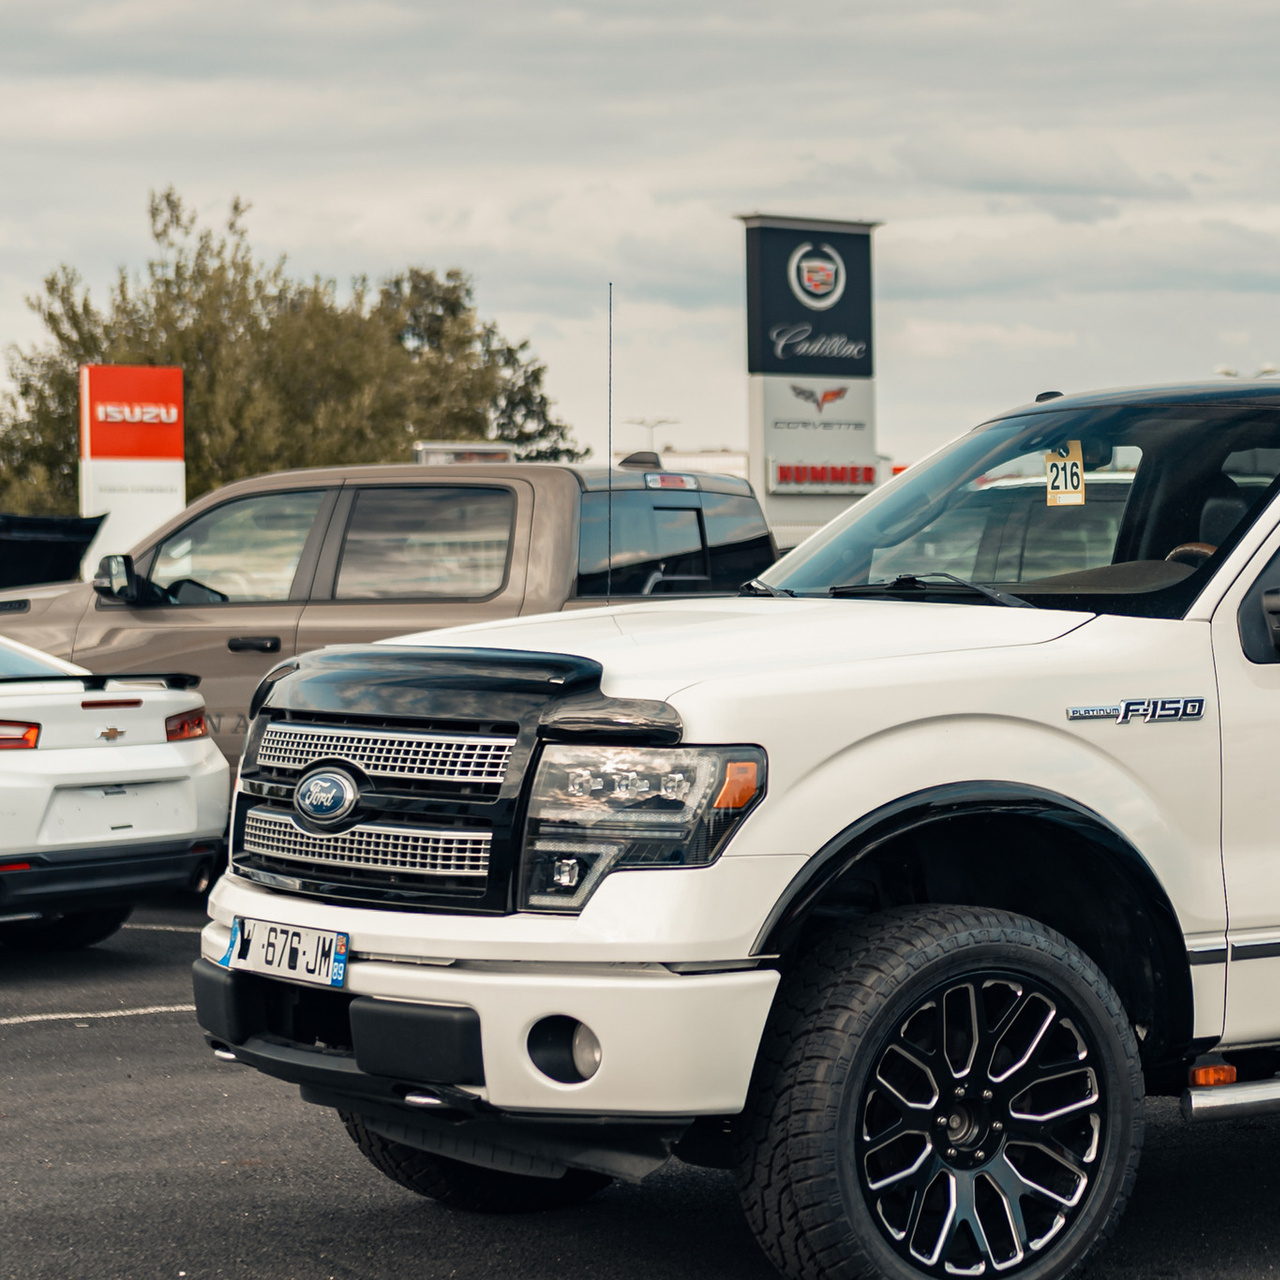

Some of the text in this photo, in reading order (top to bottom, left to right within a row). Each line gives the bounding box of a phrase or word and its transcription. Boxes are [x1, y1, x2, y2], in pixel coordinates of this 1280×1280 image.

[770, 322, 866, 359] Cadillac
[97, 404, 178, 424] ISUZU
[773, 420, 866, 431] CORVETTE
[777, 465, 875, 484] HUMMER
[1050, 462, 1080, 490] 216
[1072, 698, 1206, 724] PLATINUM F-150
[305, 780, 337, 807] Ford
[332, 962, 345, 980] 89
